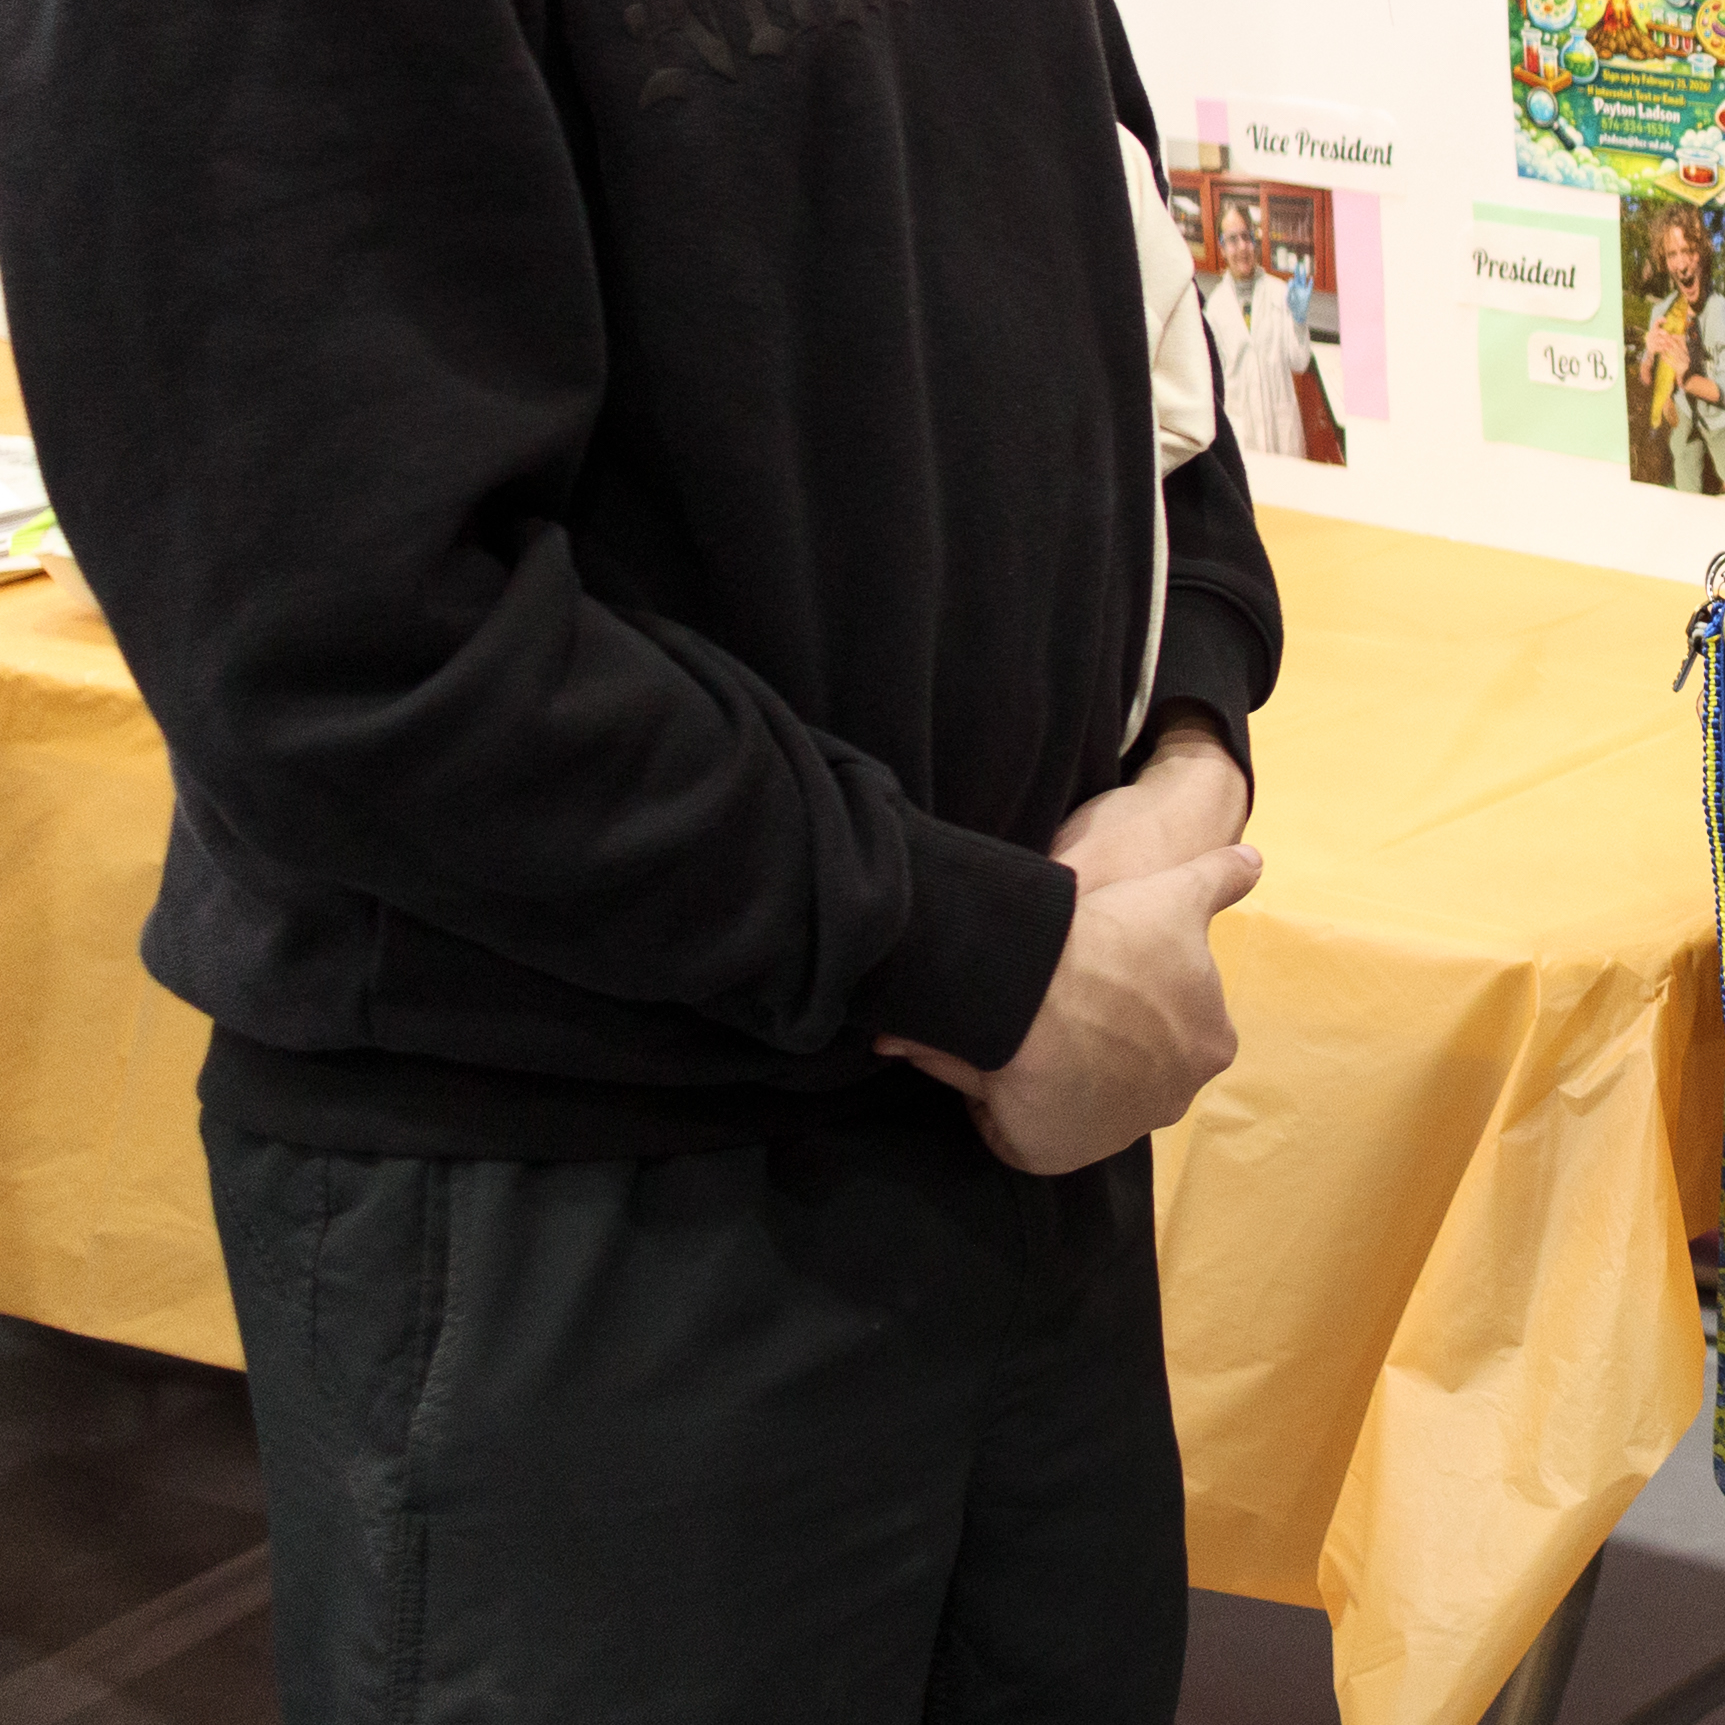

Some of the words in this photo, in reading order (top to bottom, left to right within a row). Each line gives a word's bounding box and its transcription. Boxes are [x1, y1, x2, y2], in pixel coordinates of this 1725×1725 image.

[1593, 97, 1636, 119] Payton
[1637, 102, 1681, 124] Ladson
[1246, 122, 1291, 155] Vice
[1295, 129, 1394, 167] President
[1473, 248, 1577, 289] President
[1544, 345, 1581, 382] Leo
[1588, 348, 1614, 382] B.
